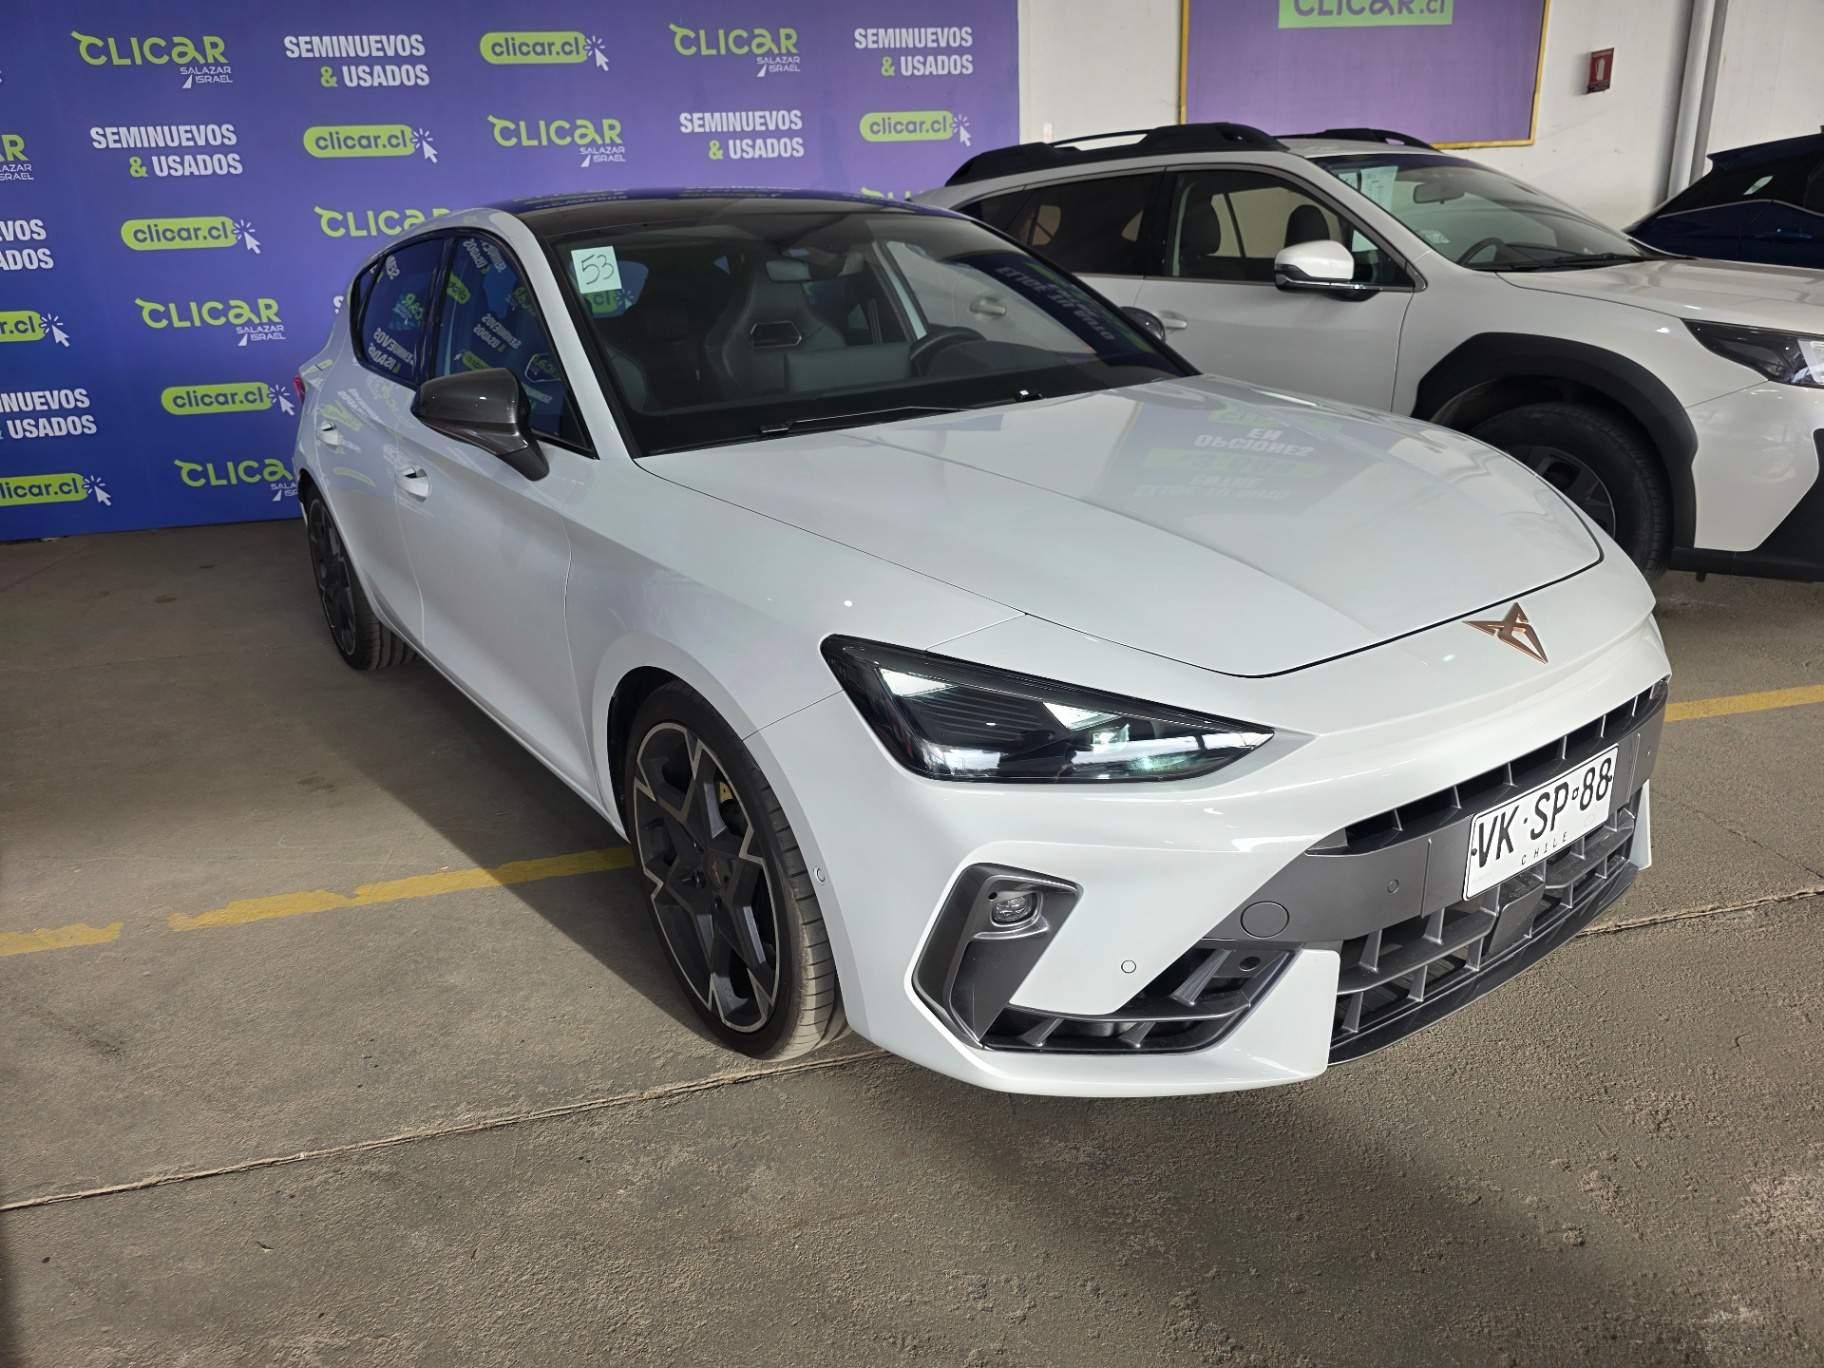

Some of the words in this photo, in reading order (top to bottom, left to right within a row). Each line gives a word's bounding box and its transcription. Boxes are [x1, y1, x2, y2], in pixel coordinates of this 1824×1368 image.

[284, 35, 425, 58] SEMINUEVOS
[490, 37, 581, 59] clicar.cl
[854, 27, 973, 49] SEMINUEVOS
[180, 66, 232, 75] SALAZAR
[756, 56, 800, 64] SALAZAR
[768, 64, 800, 72] ISRAEL
[881, 56, 895, 77] &
[900, 55, 973, 76] USADOS
[195, 75, 233, 84] ISRAEL
[320, 66, 337, 88] &
[342, 64, 430, 87] USADOS
[680, 110, 801, 133] SEMINUEVOS
[869, 114, 948, 136] clicar.cl
[90, 125, 237, 149] SEMINUEVOS
[314, 131, 407, 151] clicar.cl
[580, 146, 625, 154] SALAZAR
[593, 154, 625, 162] ISRAEL
[708, 140, 723, 160] &
[729, 138, 804, 158] USADOS
[129, 156, 148, 178] &
[151, 154, 243, 176] USADOS
[133, 219, 228, 243] clicar.cl
[581, 254, 615, 285] 53
[236, 325, 284, 334] SALAZAR
[250, 333, 286, 341] ISRAEL
[171, 386, 264, 409] clicar.cl
[7, 415, 97, 439] USADOS
